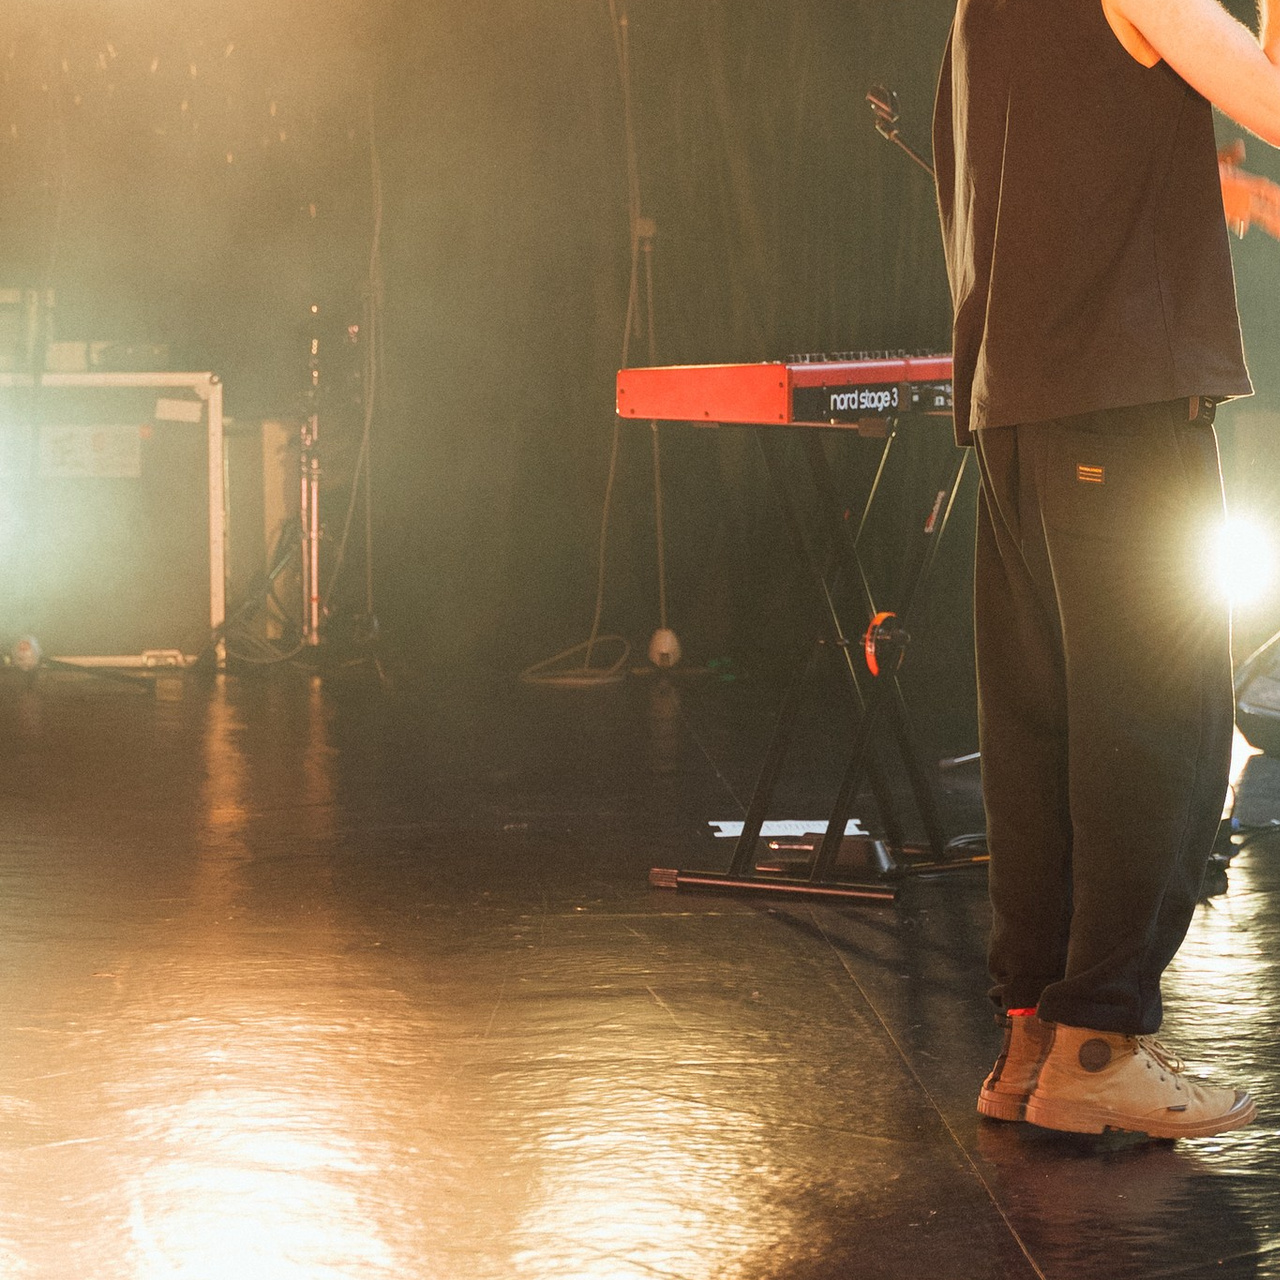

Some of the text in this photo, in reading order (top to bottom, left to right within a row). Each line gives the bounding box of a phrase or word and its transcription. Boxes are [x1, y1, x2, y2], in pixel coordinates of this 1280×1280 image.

[830, 387, 898, 412] nord stage 3
